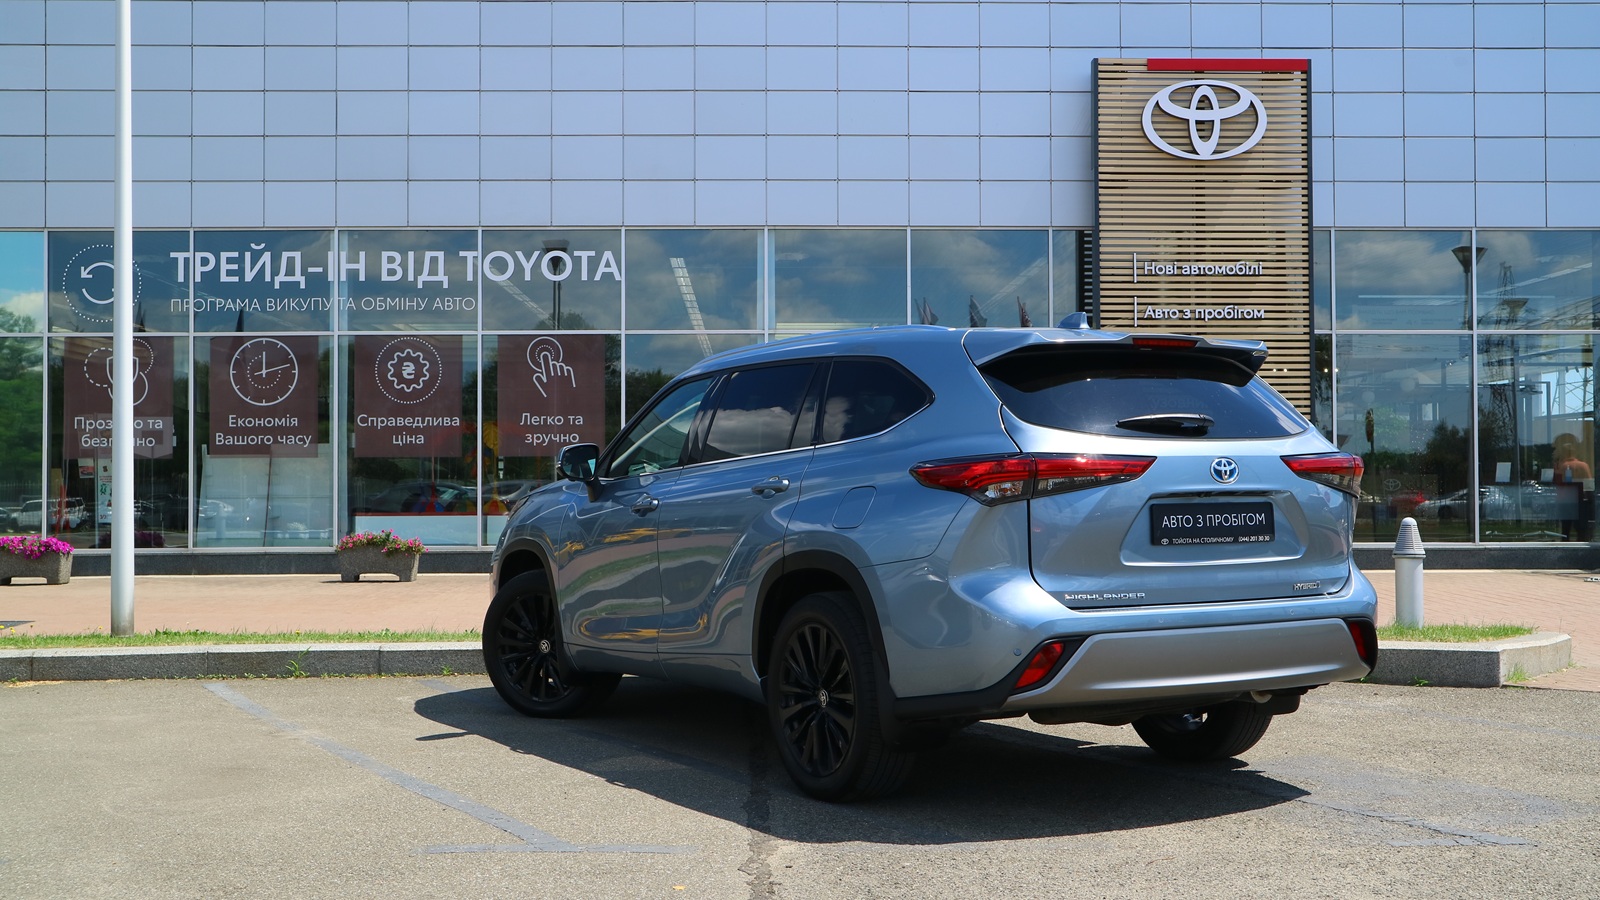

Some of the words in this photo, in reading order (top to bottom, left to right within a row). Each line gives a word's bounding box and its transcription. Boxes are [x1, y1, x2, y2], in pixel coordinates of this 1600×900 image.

[170, 243, 366, 289] ТРЕЙД-ІН
[381, 251, 449, 288] ВІД
[459, 250, 622, 282] TOYOTA
[1144, 261, 1178, 275] Нові
[1182, 261, 1263, 275] автомобілі
[170, 298, 261, 312] ПРОГРАМА
[266, 298, 334, 312] ВИКУПУ
[337, 297, 356, 311] ТА
[361, 297, 428, 311] ОБМІНУ
[432, 297, 476, 311] АВТО
[1144, 305, 1179, 319] Авто
[1182, 309, 1191, 319] з
[1195, 305, 1265, 322] пробігом
[74, 416, 143, 432] Прозо
[147, 419, 163, 429] та
[228, 414, 298, 427] Економія
[357, 414, 460, 429] Справедлива
[519, 413, 564, 425] Легко
[567, 415, 584, 425] та
[215, 432, 273, 445] Вашого
[277, 434, 312, 448] часу
[392, 432, 425, 445] ціна
[524, 432, 580, 444] зручно
[1162, 515, 1193, 528] АВТО
[1206, 512, 1266, 526] ПРОБІГОМ
[1172, 537, 1192, 545] ТОЙОТА
[1200, 536, 1234, 544] СТОЛИЧНОМУ
[1293, 582, 1317, 591] HYBRID
[1064, 592, 1146, 601] HIGHLANDER
